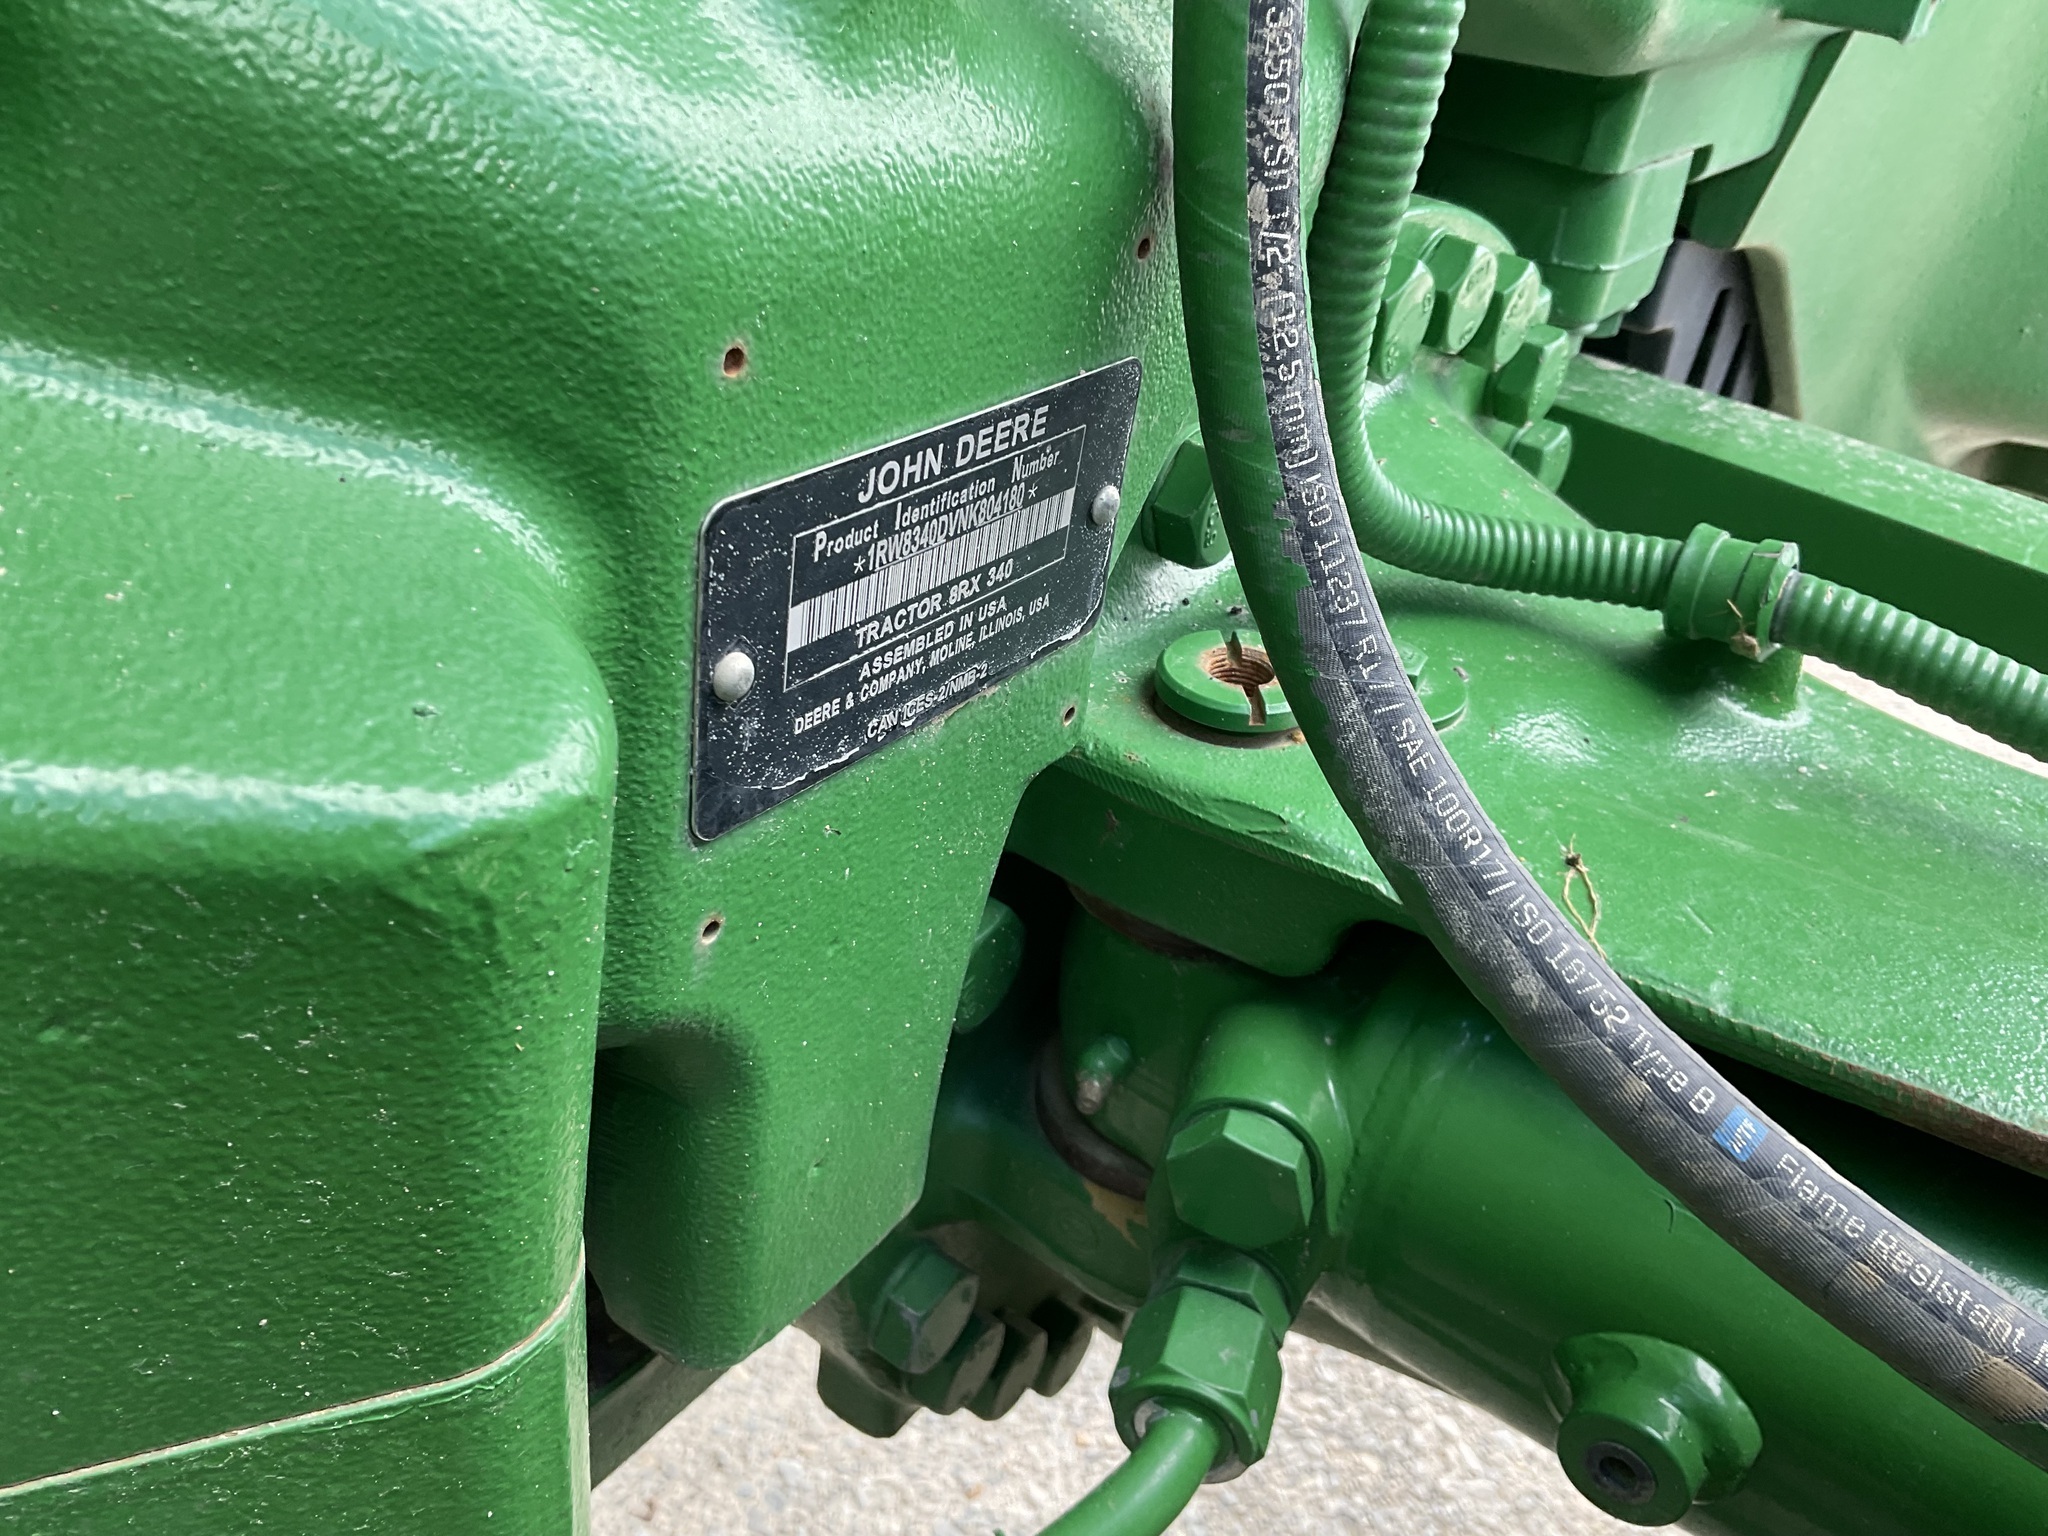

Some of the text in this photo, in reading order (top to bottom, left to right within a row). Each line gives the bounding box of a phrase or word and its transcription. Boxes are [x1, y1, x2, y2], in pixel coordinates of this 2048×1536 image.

[1264, 6, 1293, 105] 3250
[858, 404, 1049, 504] JOHN DEERE
[813, 449, 1060, 562] Product Identification Number
[1300, 473, 1333, 527] ISO
[855, 557, 1014, 648] TRACTOR 8RX 340
[1314, 531, 1368, 626] 11237
[794, 592, 1050, 736] DEERE & COMPANY, MOLINE, ILLINOIS, USA
[858, 595, 1008, 682] ASSEMBLED IN USA
[867, 661, 988, 738] CAN ICES-2/NMB-2
[1391, 717, 1436, 777] SAE
[1508, 894, 1553, 945] ISO
[1545, 941, 1630, 1033] 18752
[1628, 1023, 1689, 1093] Type
[1688, 1085, 1716, 1114] B
[1774, 1153, 1866, 1239] Flame
[1870, 1228, 2026, 1353] Resistant
